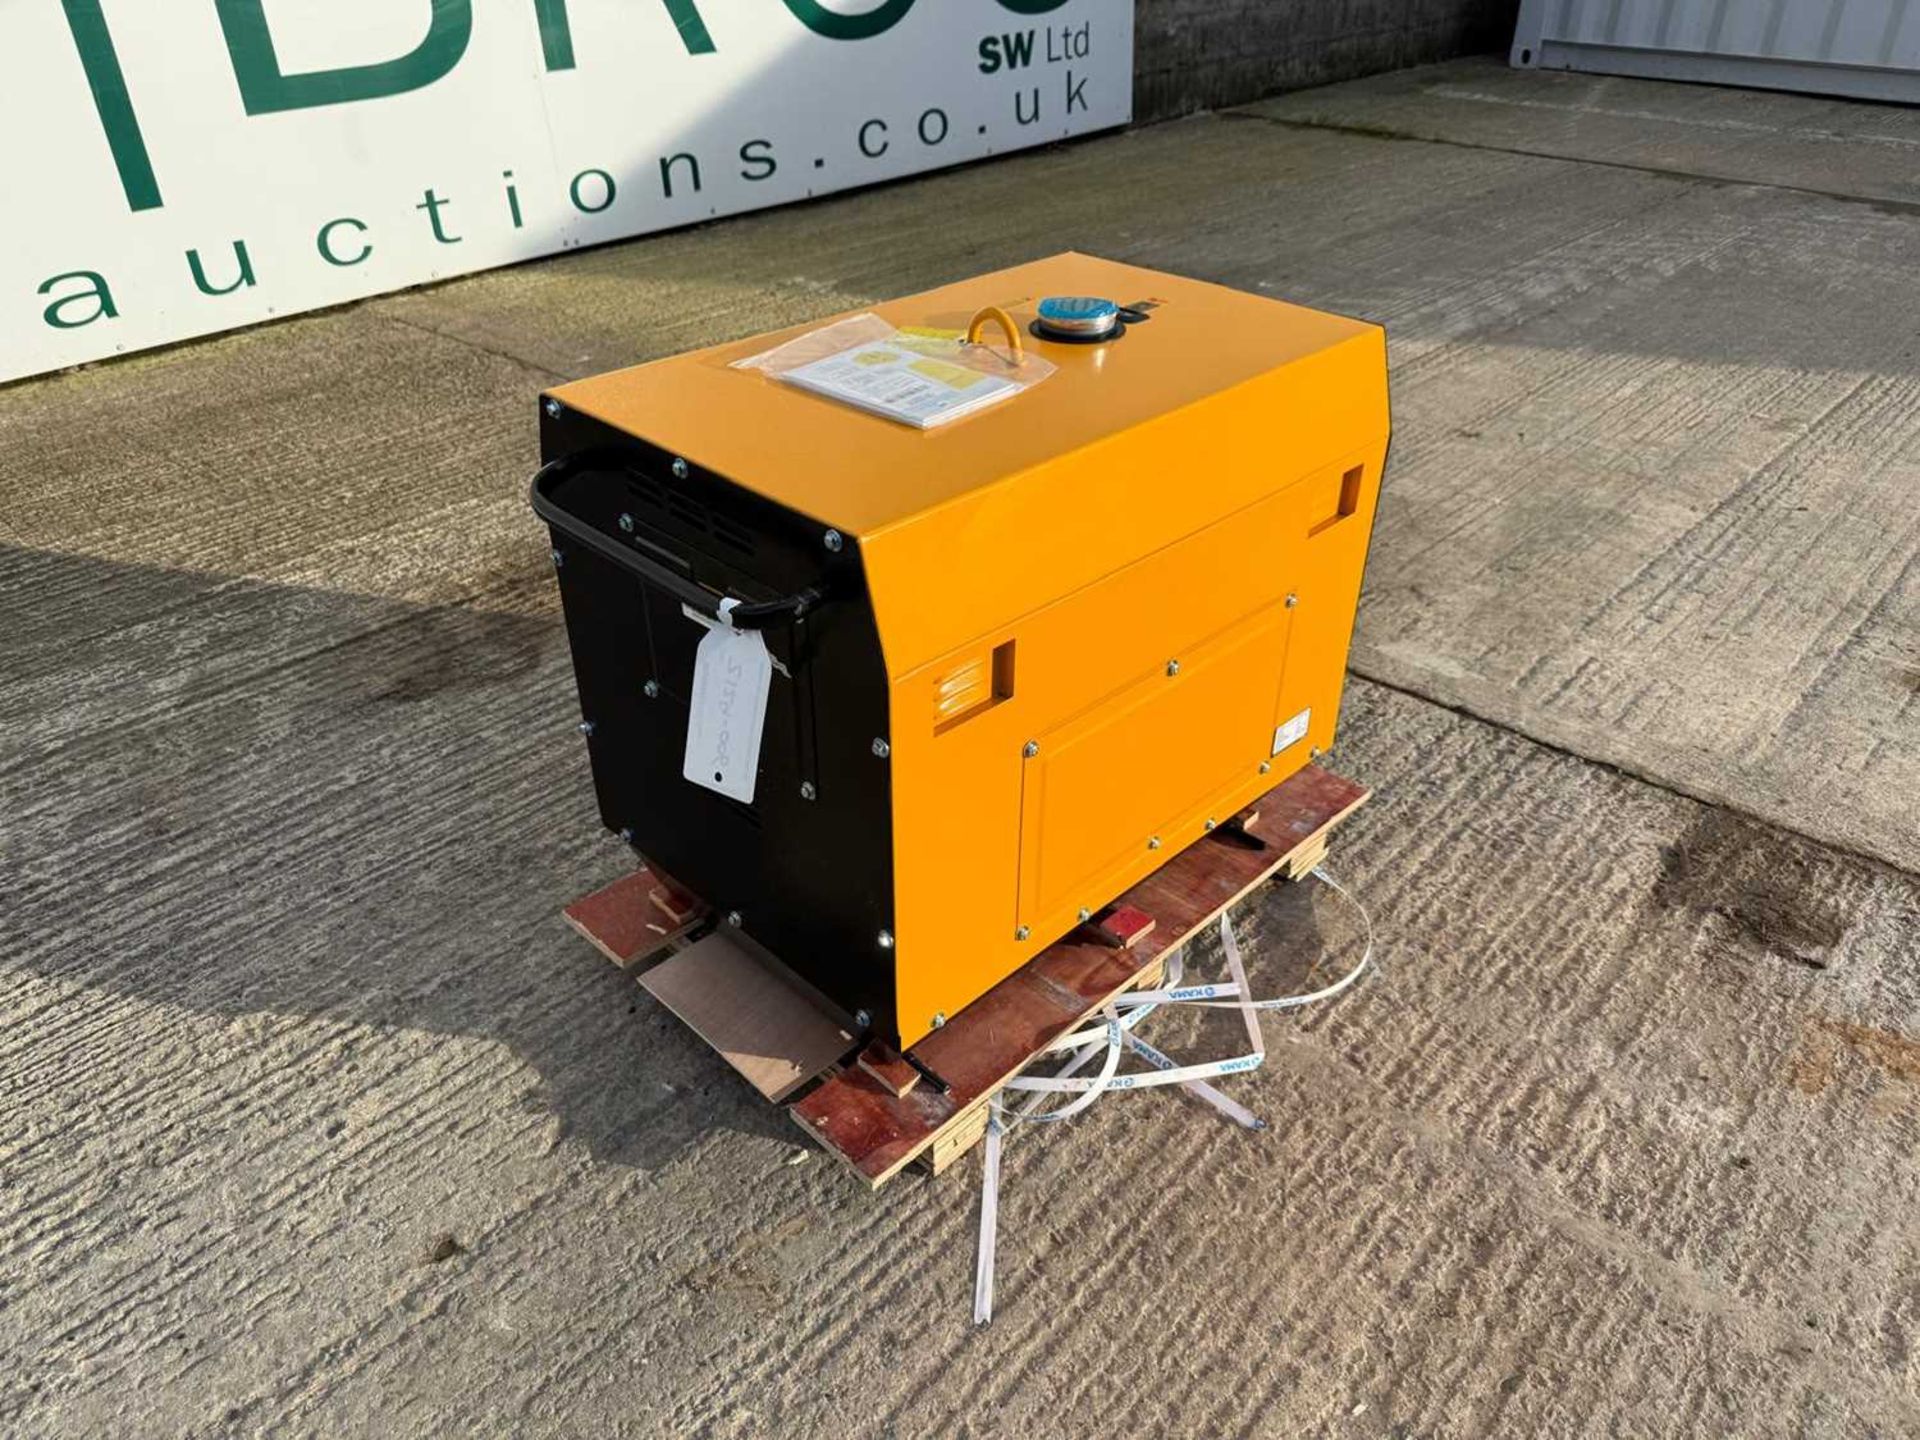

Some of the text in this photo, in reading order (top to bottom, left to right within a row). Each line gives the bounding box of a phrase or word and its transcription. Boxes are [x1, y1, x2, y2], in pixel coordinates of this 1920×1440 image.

[978, 20, 1090, 74] SW Ltd
[36, 70, 1089, 329] auctions.co.uk
